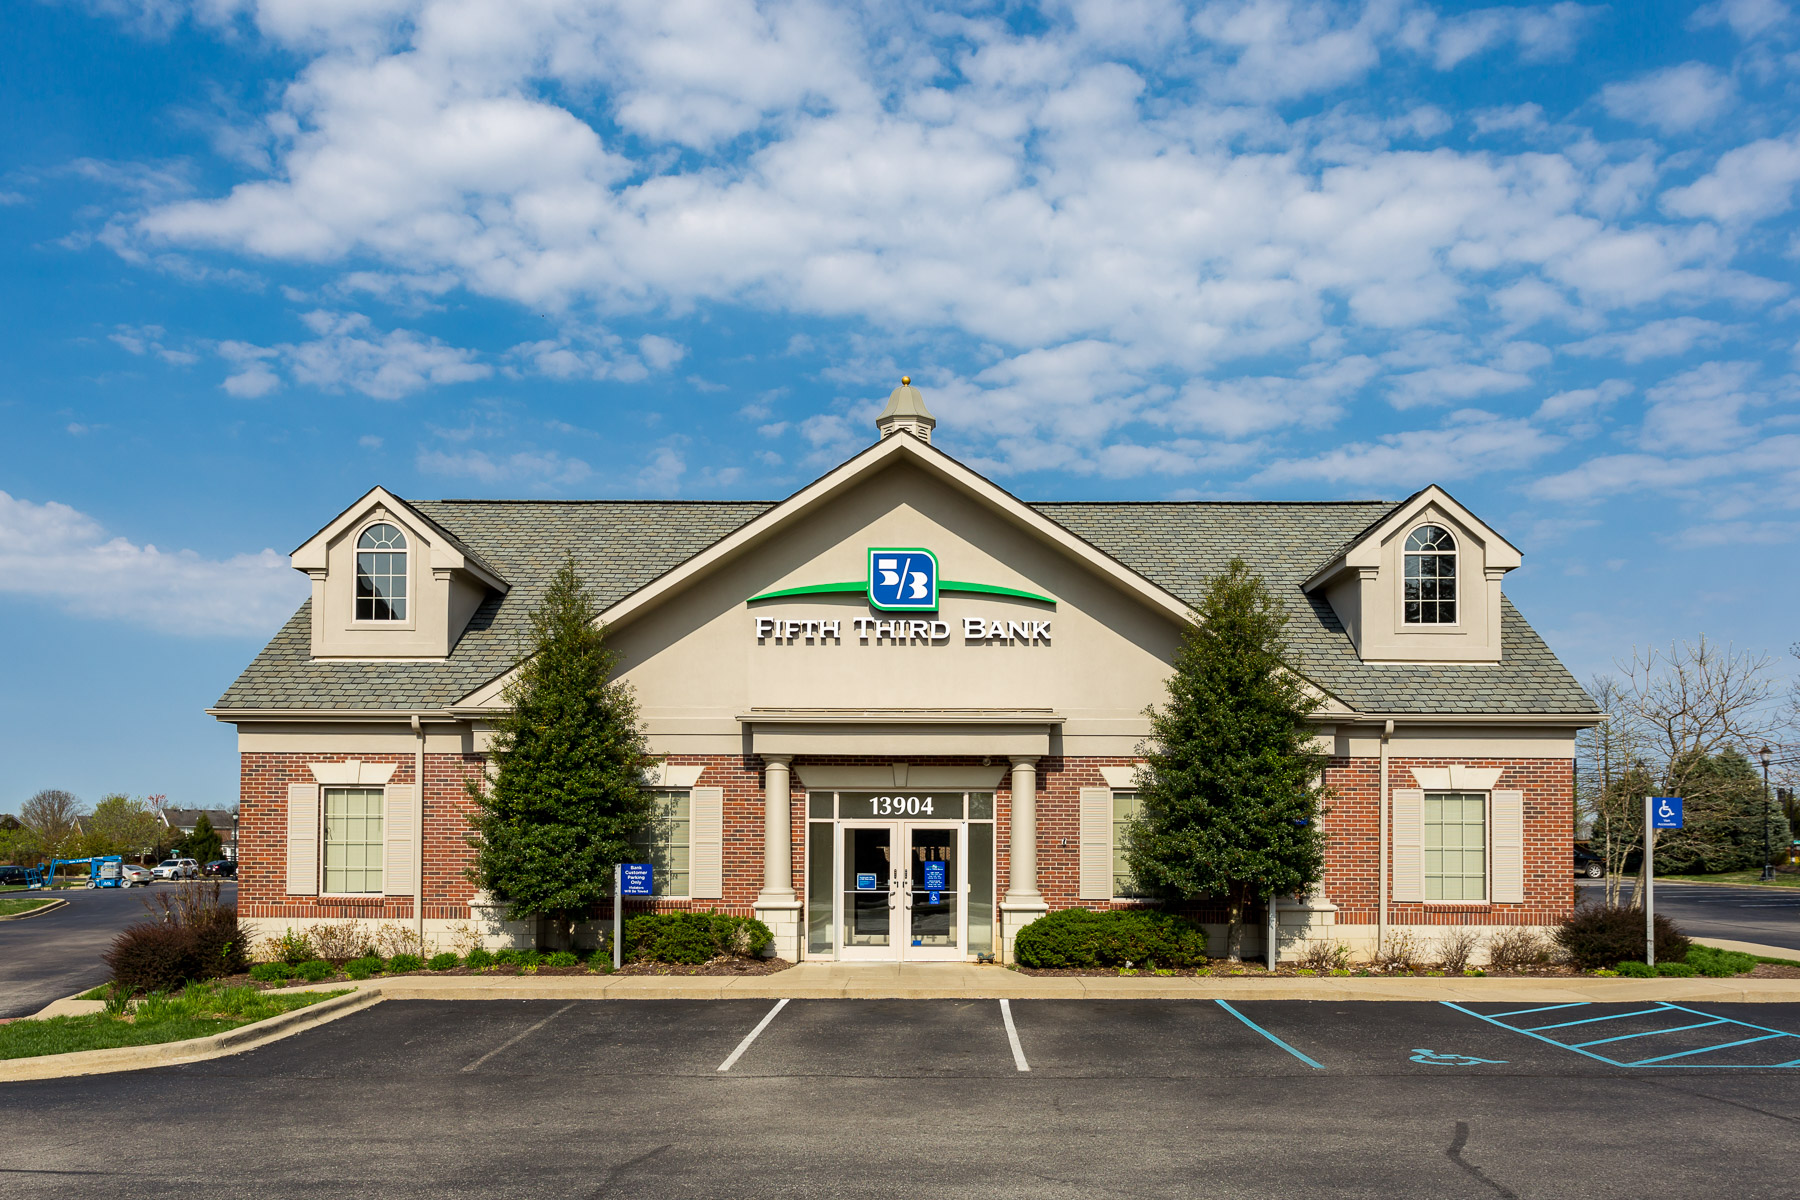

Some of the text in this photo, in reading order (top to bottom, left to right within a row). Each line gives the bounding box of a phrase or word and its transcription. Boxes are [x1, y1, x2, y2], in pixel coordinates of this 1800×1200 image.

[755, 617, 1052, 639] FIFTH THIRD BANK
[869, 796, 934, 815] 13904
